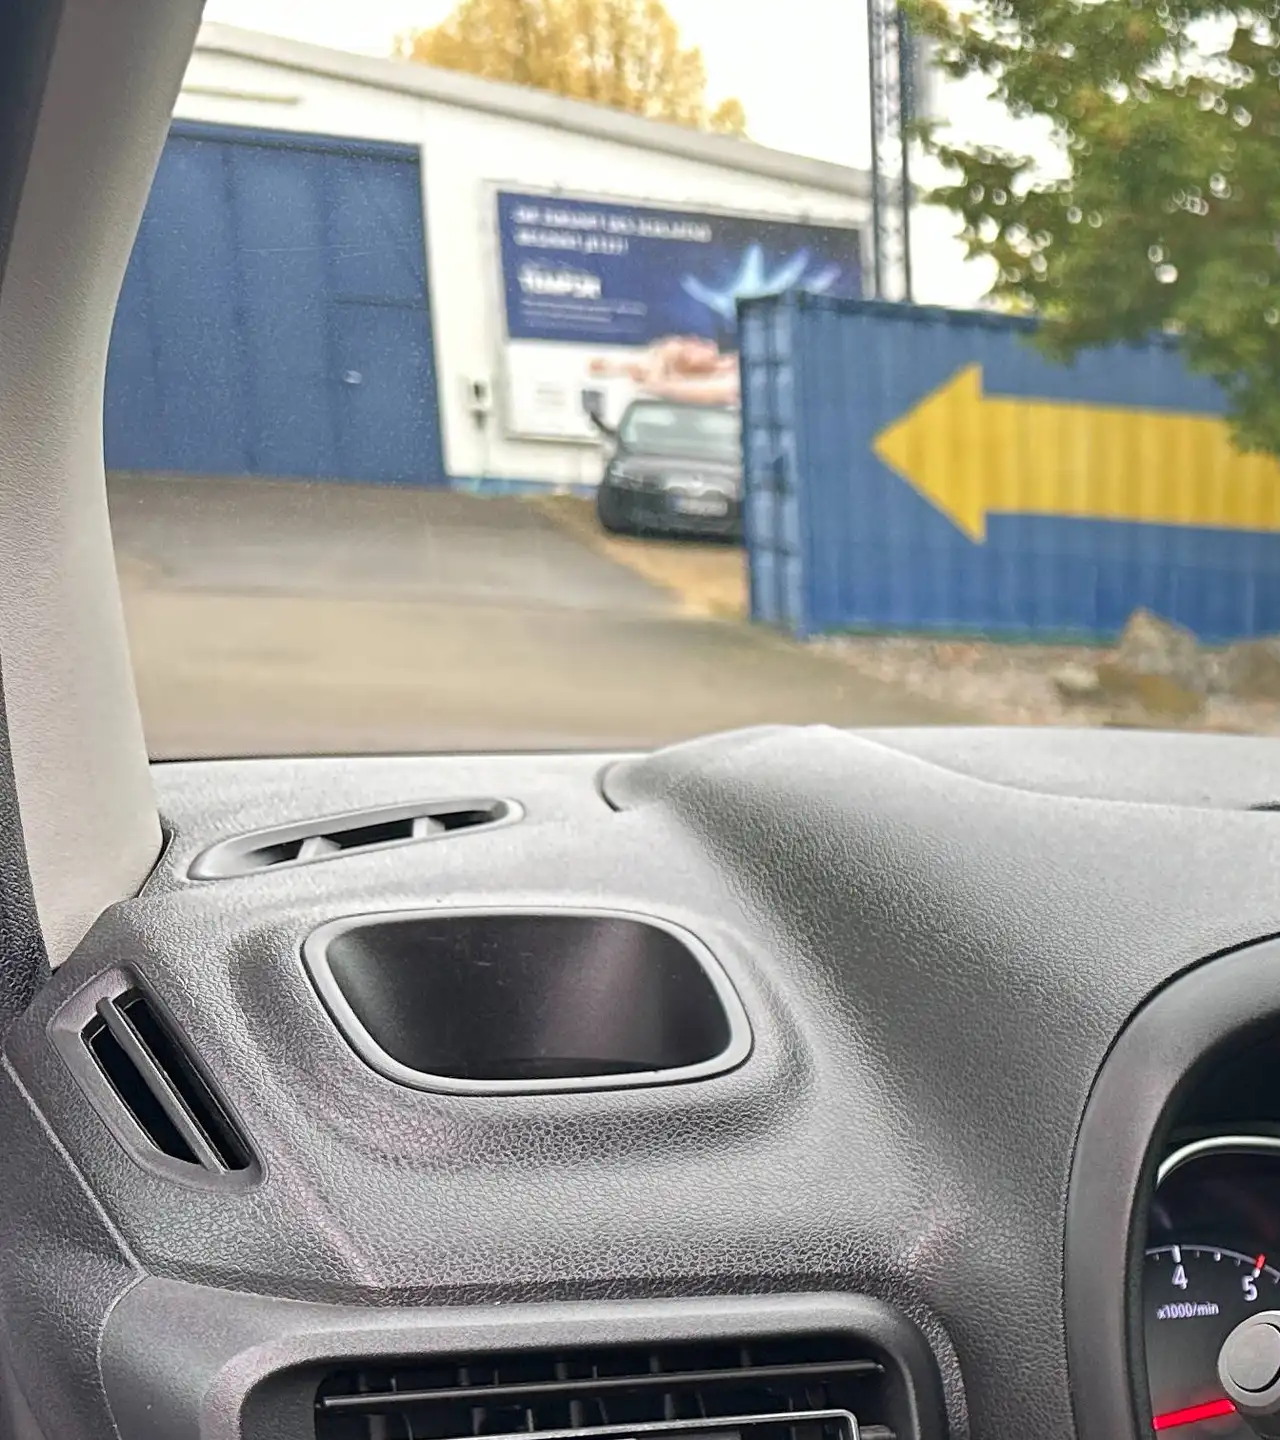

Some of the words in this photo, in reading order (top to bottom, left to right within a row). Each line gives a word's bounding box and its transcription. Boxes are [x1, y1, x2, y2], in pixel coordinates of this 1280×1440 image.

[1172, 1264, 1189, 1290] 4
[1242, 1275, 1258, 1301] 5
[1157, 1301, 1220, 1320] x1000/min
